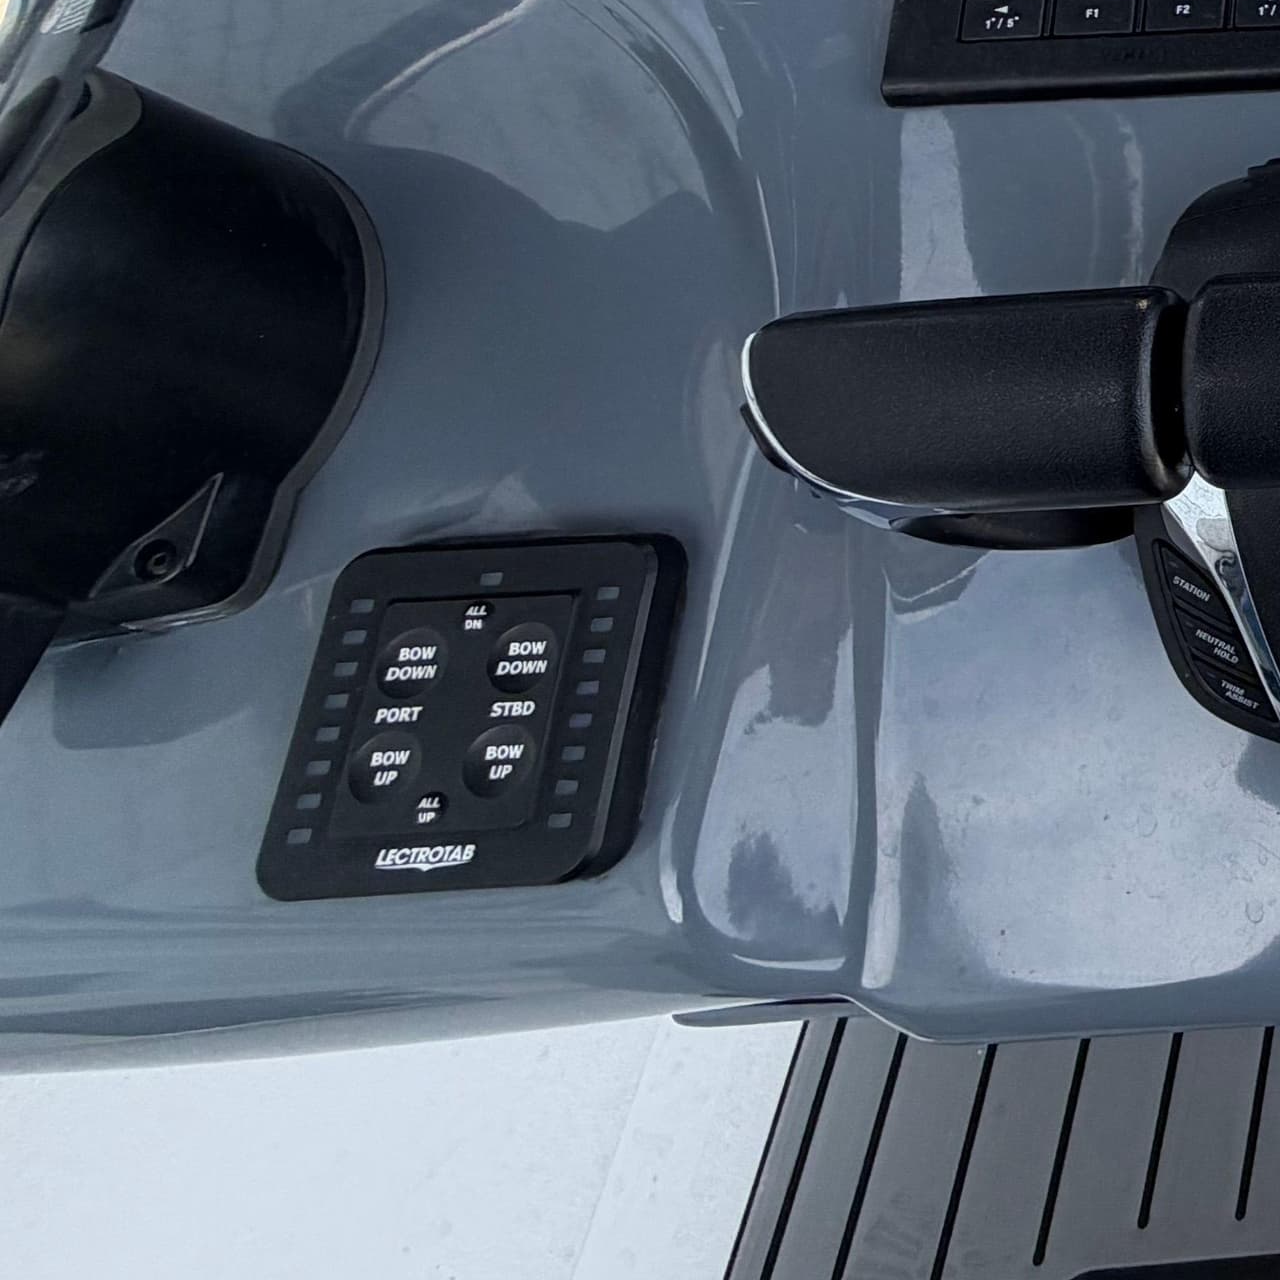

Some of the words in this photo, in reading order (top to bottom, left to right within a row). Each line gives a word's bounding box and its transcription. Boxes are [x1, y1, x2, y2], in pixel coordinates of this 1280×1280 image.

[1085, 8, 1100, 19] F1
[1176, 4, 1191, 15] F2
[1172, 575, 1211, 602] STATION
[464, 604, 488, 617] ALL
[464, 619, 483, 631] DN
[508, 641, 547, 656] BOW
[1195, 628, 1237, 655] NEUTRAL
[398, 646, 437, 661] BOW
[1213, 646, 1239, 665] HOLD
[385, 664, 438, 681] DOWN
[495, 660, 548, 676] DOWN
[1220, 679, 1246, 696] TRIM
[1225, 690, 1261, 710] ASSIST
[374, 706, 423, 724] PORT
[489, 701, 536, 718] STBD
[370, 750, 410, 767] BOW
[484, 744, 525, 761] BOW
[373, 770, 398, 787] UP
[489, 764, 513, 780] UP
[417, 797, 441, 809] ALL
[418, 812, 436, 824] UP
[374, 845, 477, 867] LECTROTAB
